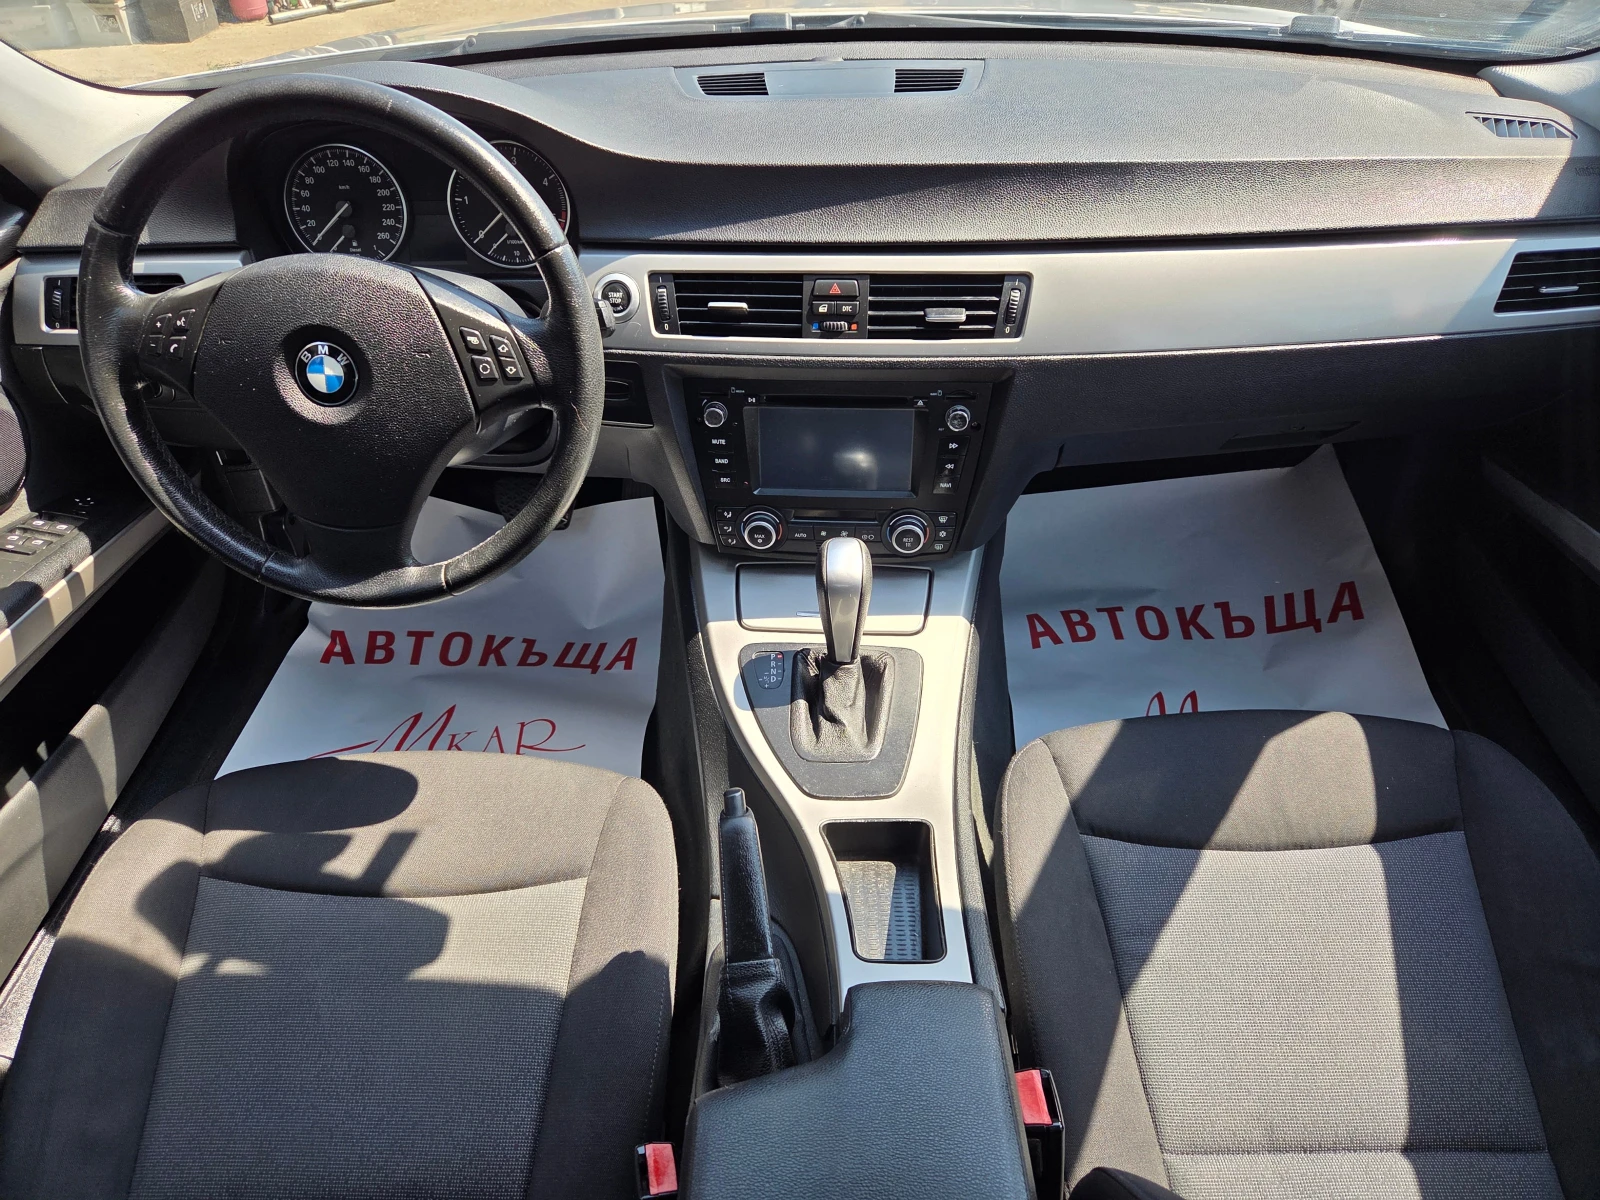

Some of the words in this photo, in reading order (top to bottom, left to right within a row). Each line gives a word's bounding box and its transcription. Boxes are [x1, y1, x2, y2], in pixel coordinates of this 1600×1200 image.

[511, 156, 517, 166] 3
[543, 178, 548, 186] 4
[464, 196, 468, 204] 1
[300, 345, 350, 366] BMW
[1025, 580, 1365, 650] АВТОКЪЩА
[319, 629, 639, 675] АВТОКЪЩА
